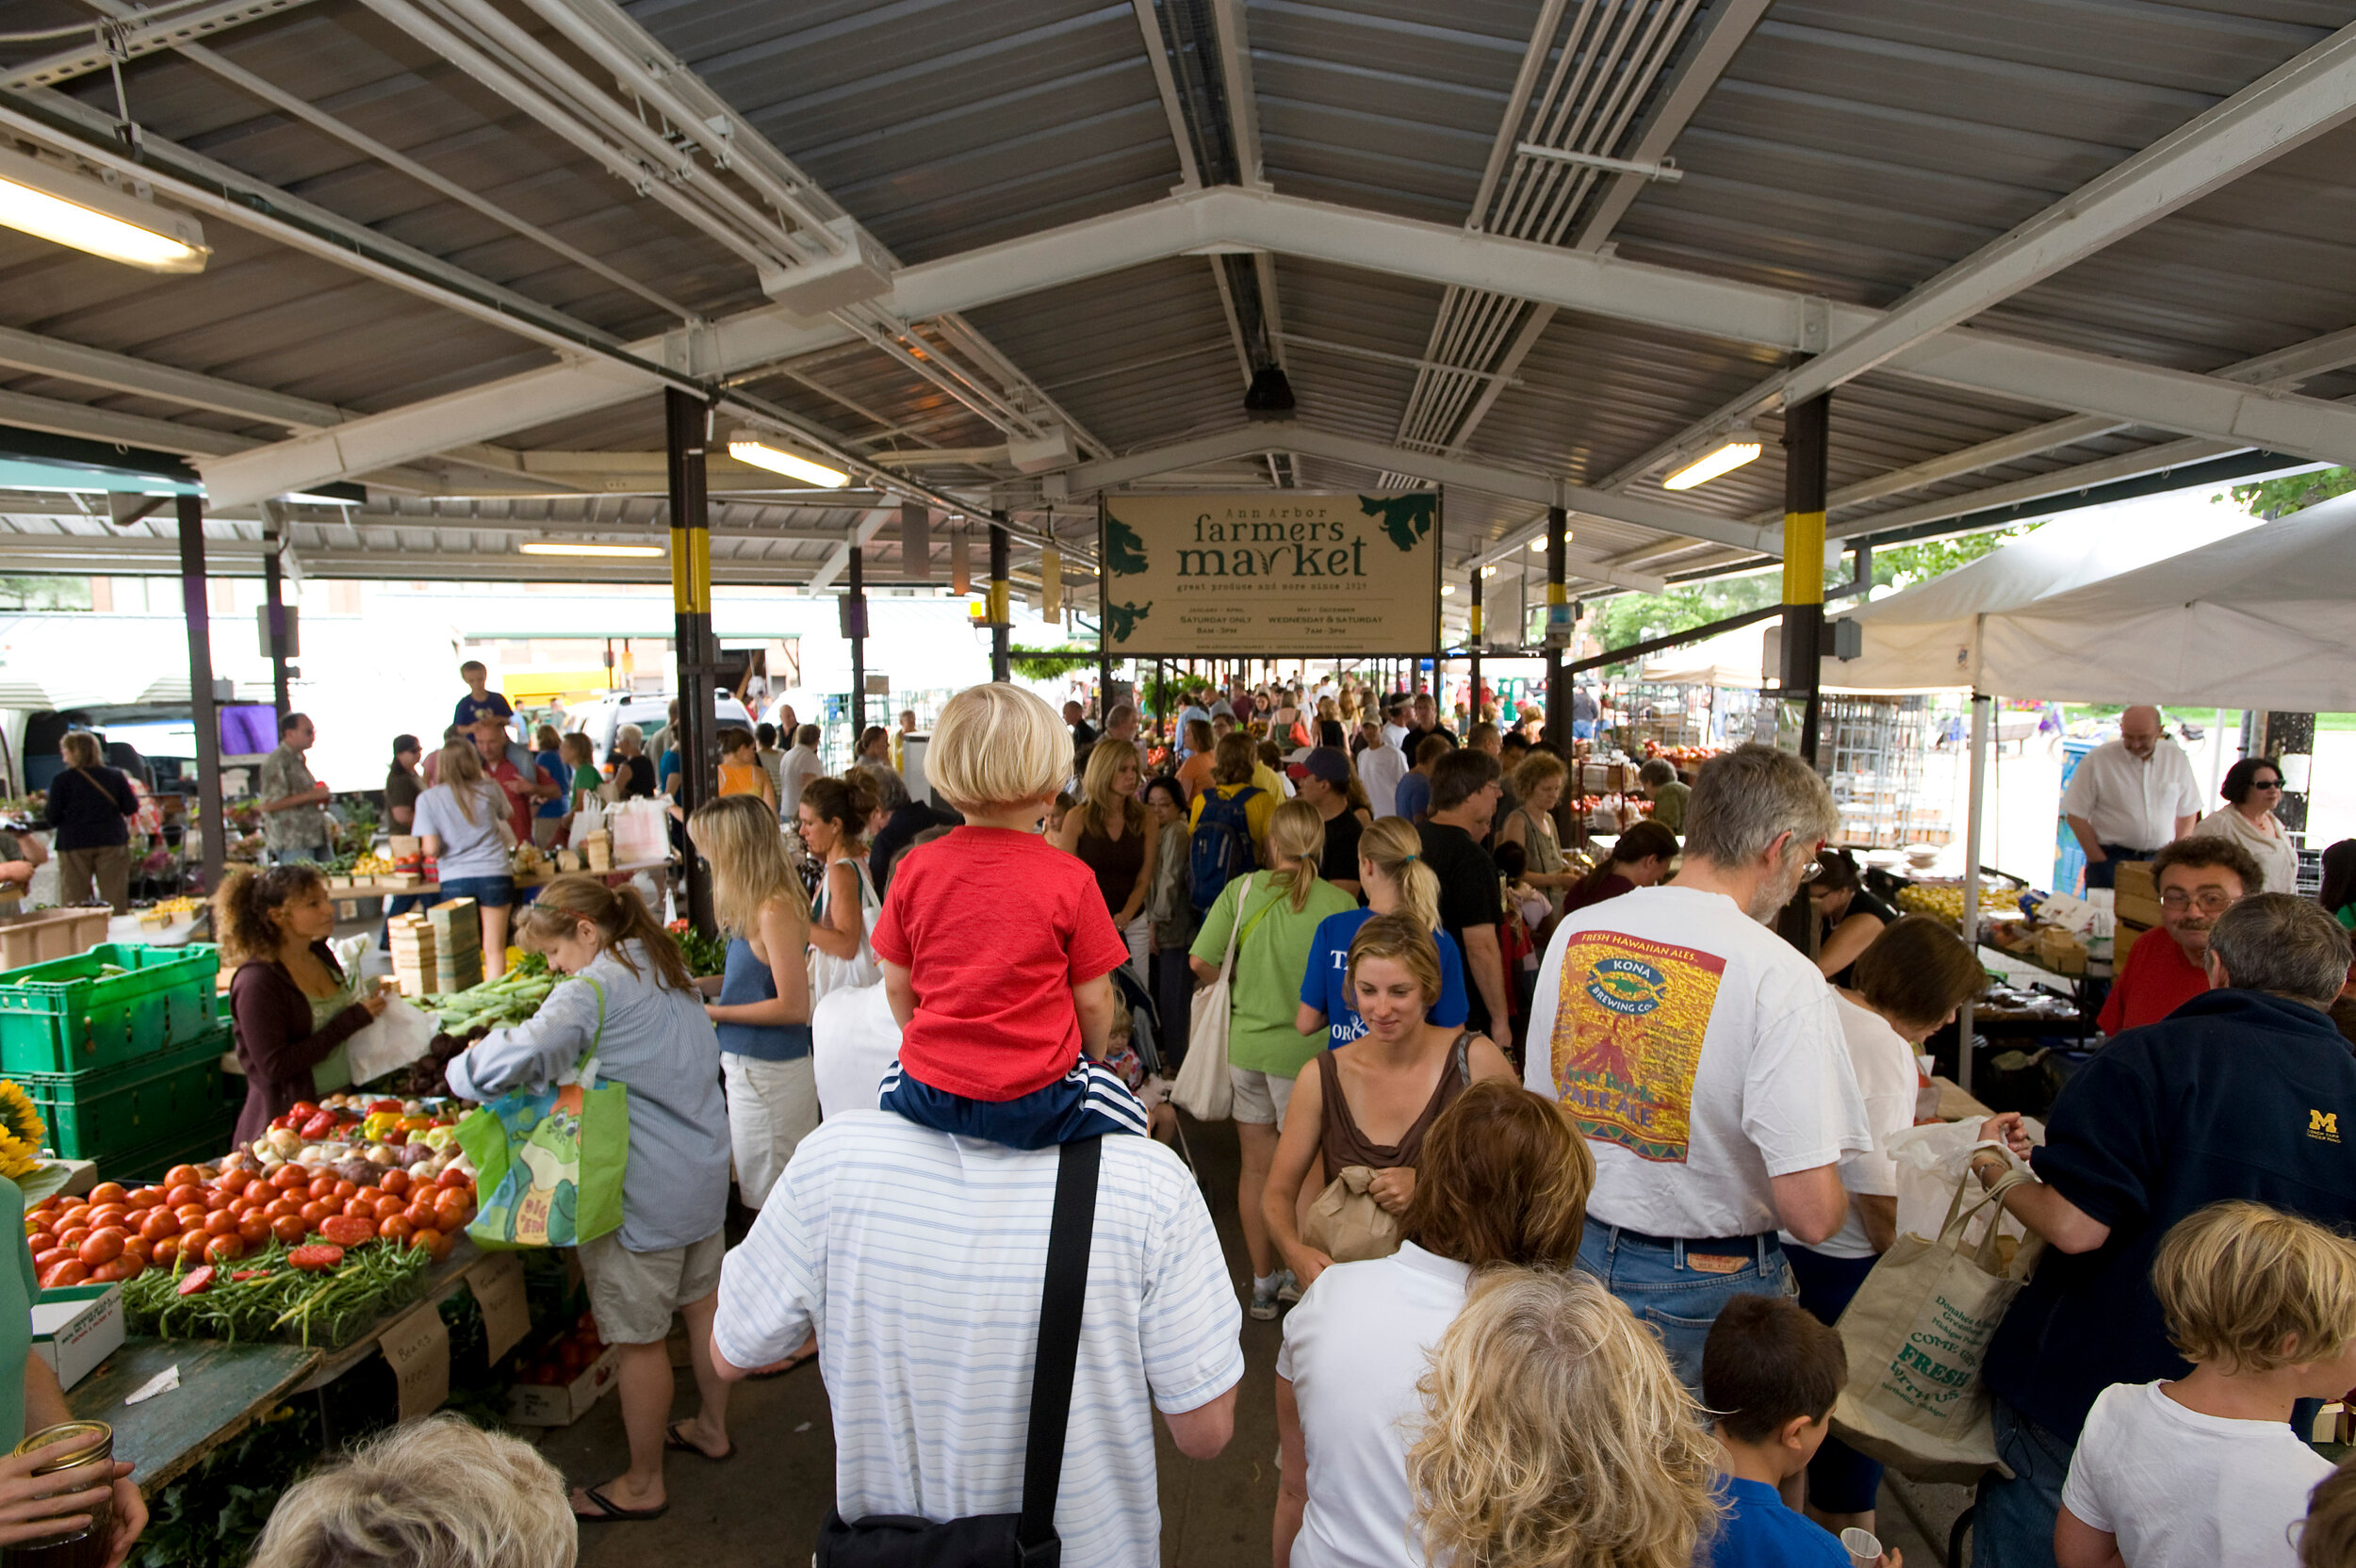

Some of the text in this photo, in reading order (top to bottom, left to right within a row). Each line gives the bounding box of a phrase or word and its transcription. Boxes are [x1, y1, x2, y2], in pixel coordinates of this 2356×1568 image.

[1227, 508, 1327, 518] Ann Arbor
[1194, 514, 1345, 543] farmers
[1176, 535, 1367, 577] market
[1177, 583, 1206, 593] great
[1212, 582, 1252, 593] produce
[1258, 582, 1276, 591] and
[1311, 582, 1340, 591] since
[1581, 934, 1611, 942] FRESH
[1612, 936, 1670, 956] HAWAIIAN
[1613, 960, 1650, 979] KONA
[1592, 987, 1635, 1013] BREWING
[1615, 1097, 1653, 1128] ALE
[2309, 1109, 2337, 1134] M
[398, 1334, 432, 1363] Beans
[1910, 1331, 1959, 1354] COME
[1897, 1342, 1972, 1388] FRESH
[1890, 1360, 1960, 1403] WITH US
